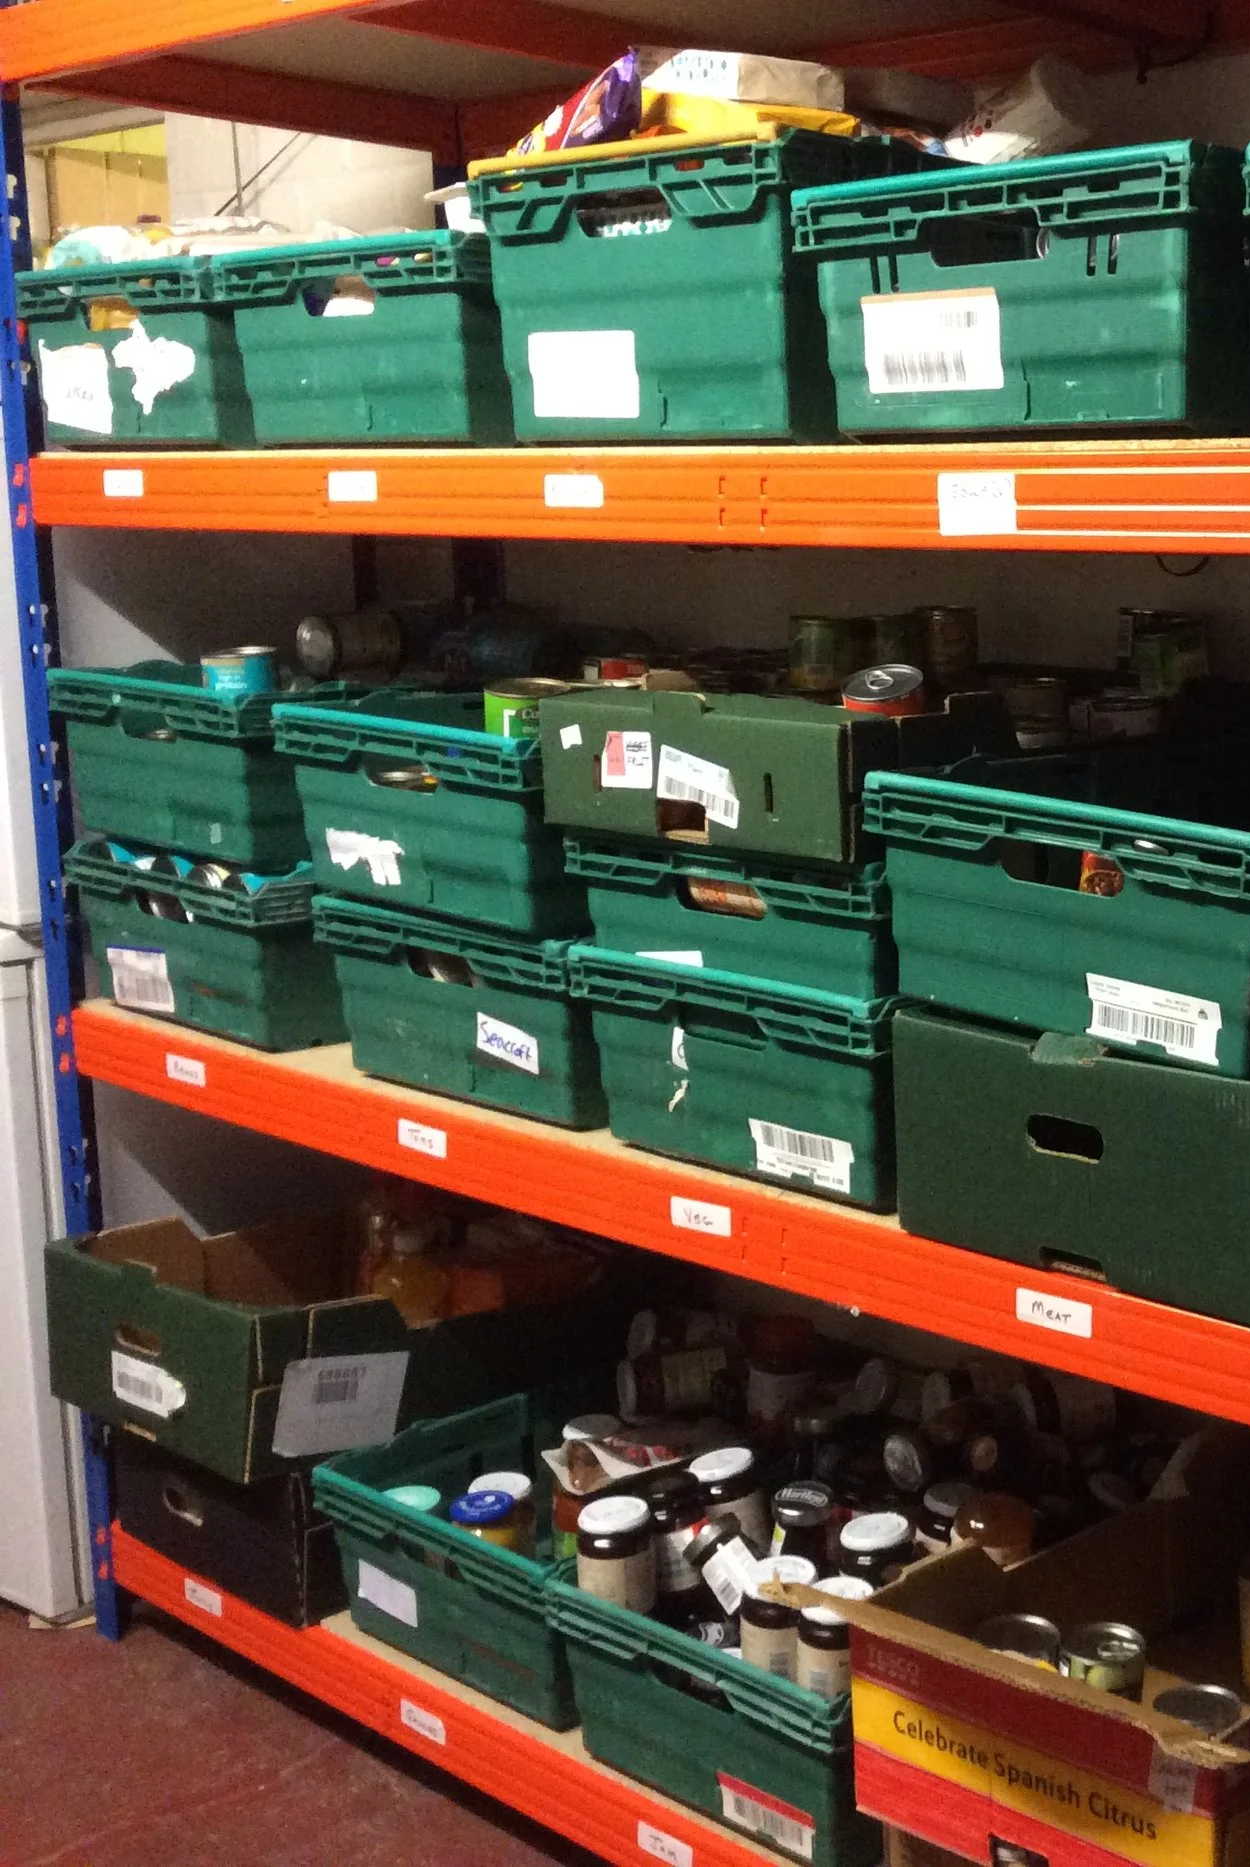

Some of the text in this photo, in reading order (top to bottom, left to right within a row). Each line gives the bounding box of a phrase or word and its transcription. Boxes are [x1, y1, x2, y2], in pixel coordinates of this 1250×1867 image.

[893, 1710, 1157, 1842] Celebrate Spanish Citrus
